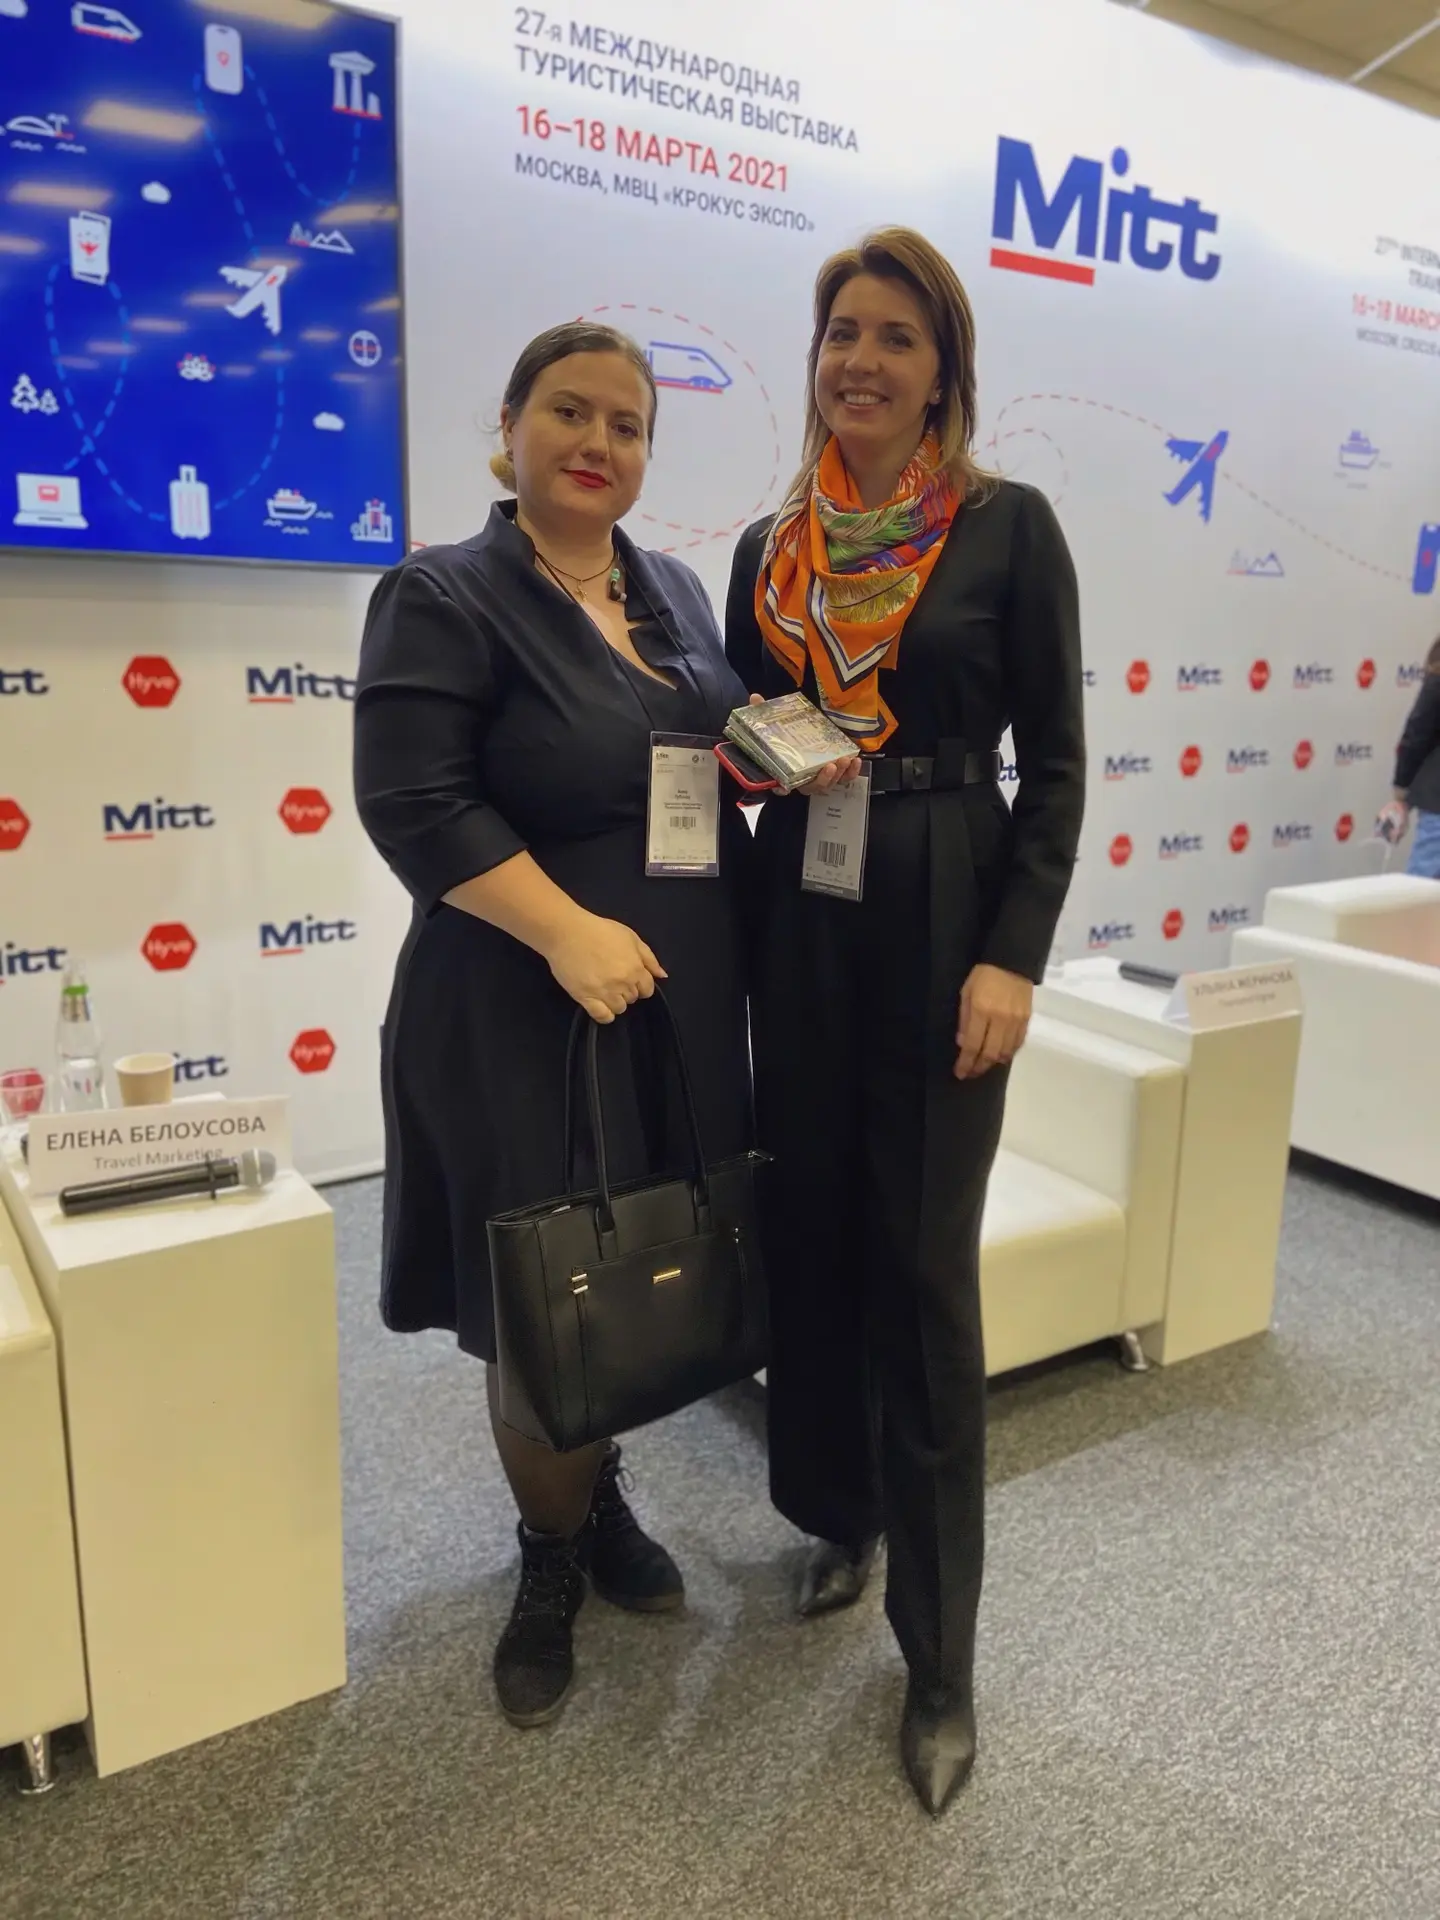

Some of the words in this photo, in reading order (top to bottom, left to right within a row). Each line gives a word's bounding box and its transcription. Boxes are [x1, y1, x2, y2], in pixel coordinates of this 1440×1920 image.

[569, 20, 800, 104] МЕЖДУНАРОДНАЯ
[514, 43, 735, 122] ТУРИСТИЧЕСКАЯ
[741, 101, 859, 153] ВЫСТАВКА
[616, 126, 719, 178] МАРТА
[728, 152, 789, 192] 2021
[515, 153, 608, 195] МОСКВА,
[613, 174, 659, 205] МВЦ
[663, 186, 746, 219] «КРОКУС
[749, 202, 816, 233] ЭКСПО»
[992, 134, 1221, 281] Mitt
[103, 797, 215, 832] Mitt
[260, 914, 356, 949] Mitt
[0, 942, 67, 975] itt
[173, 1052, 229, 1083] itt
[47, 1128, 123, 1151] ЕЛЕНА
[130, 1116, 266, 1144] БЕЛОУСОВА
[94, 1152, 142, 1171] Travel
